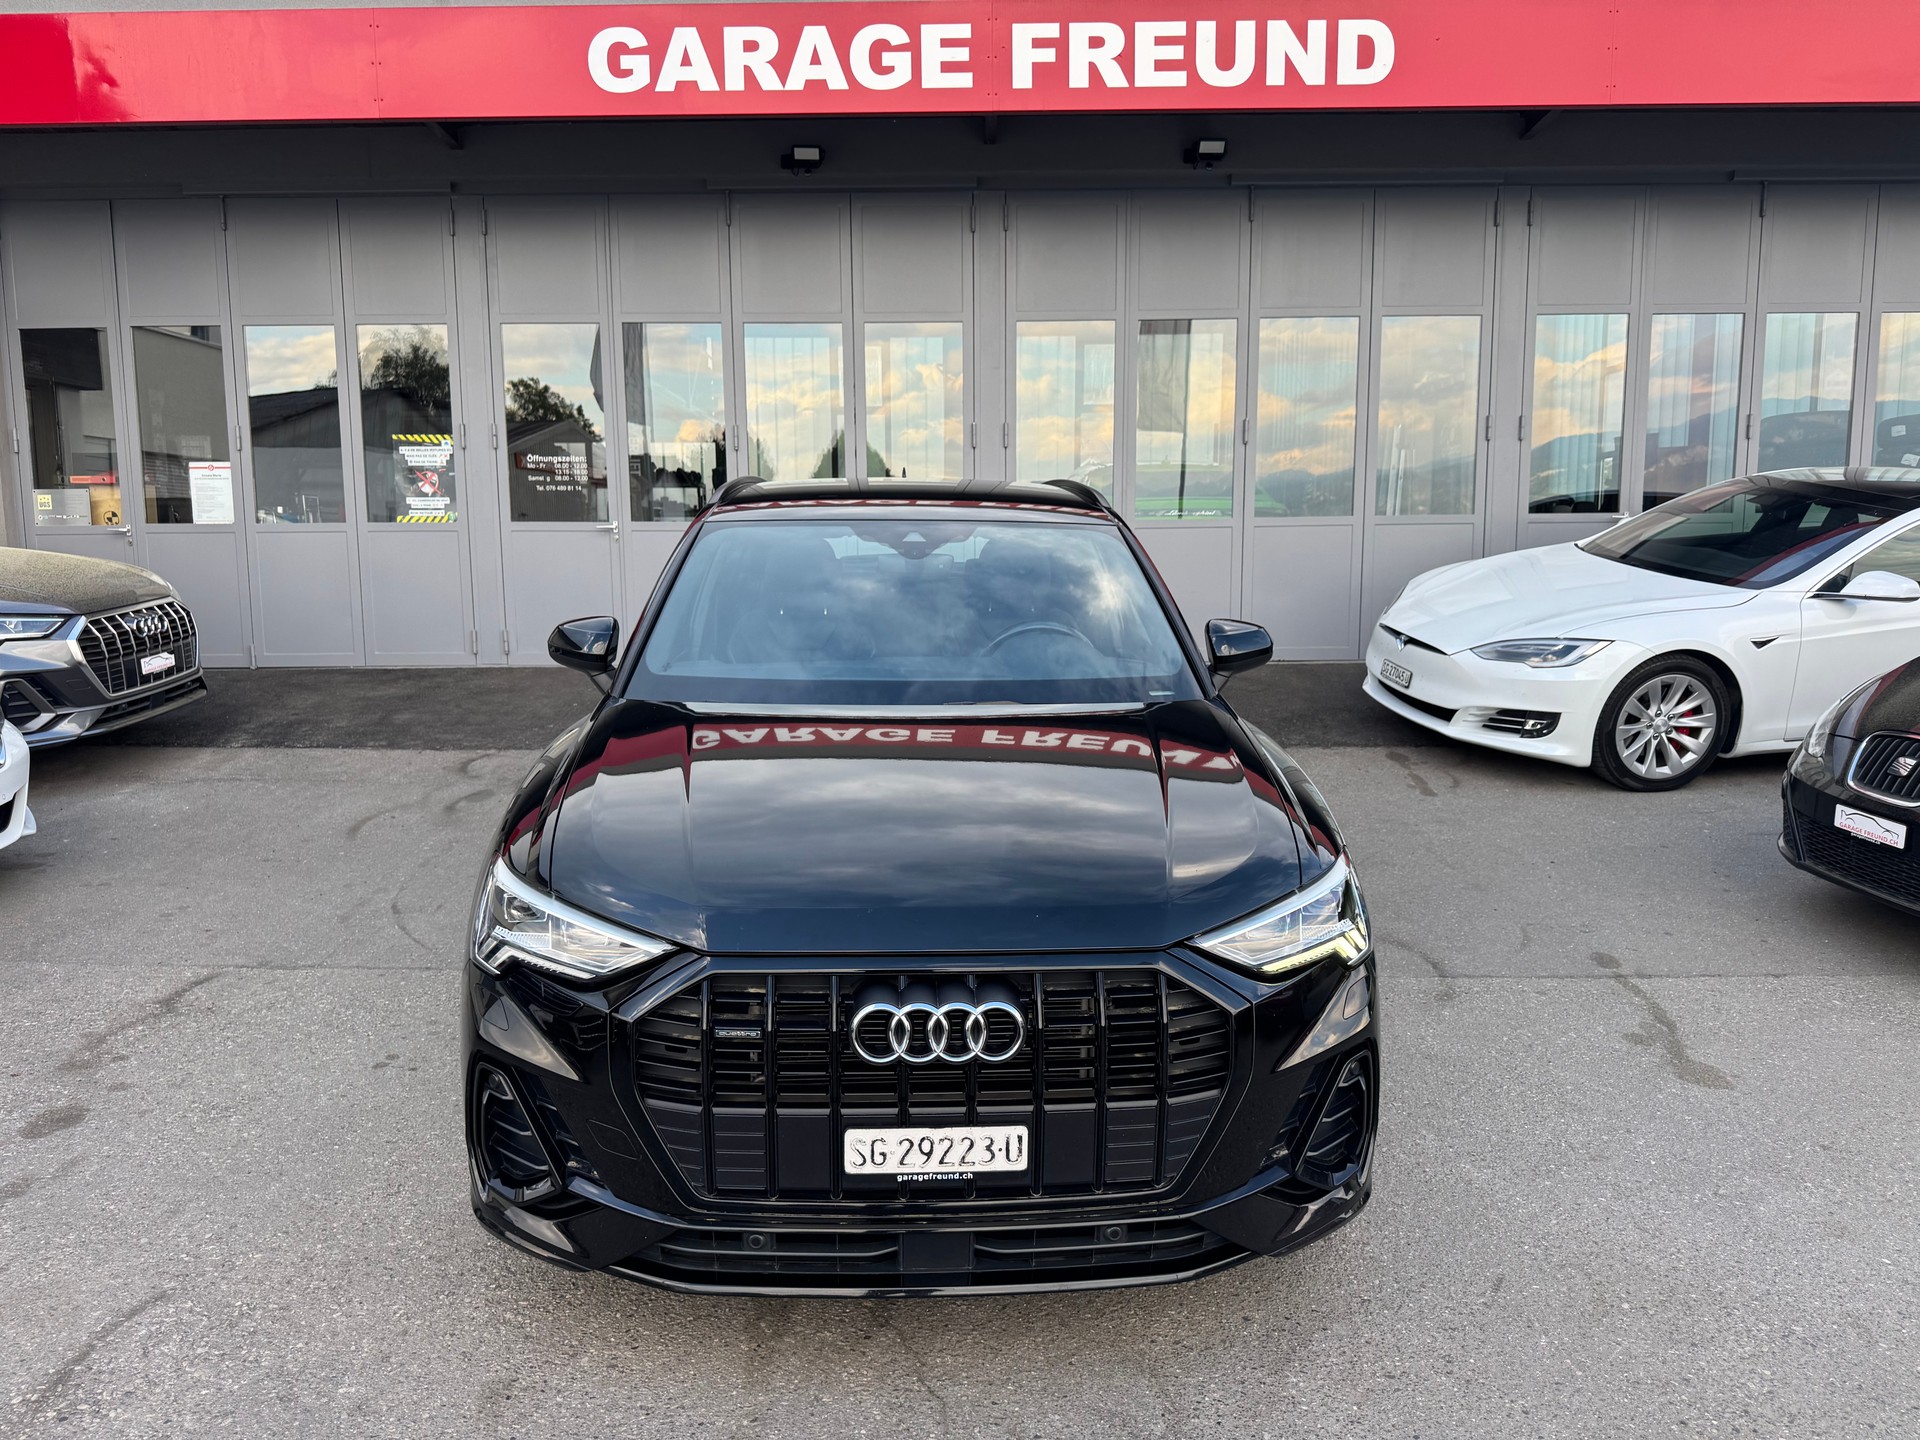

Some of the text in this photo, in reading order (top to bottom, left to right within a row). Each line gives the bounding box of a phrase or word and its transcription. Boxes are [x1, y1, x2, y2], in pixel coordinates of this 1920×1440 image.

[587, 19, 1395, 94] GARAGE FREUND
[526, 454, 587, 463] Öffnungszeiten:
[1839, 822, 1899, 847] GARAGE FREUND.CH
[897, 1172, 973, 1182] garagefreund.ch
